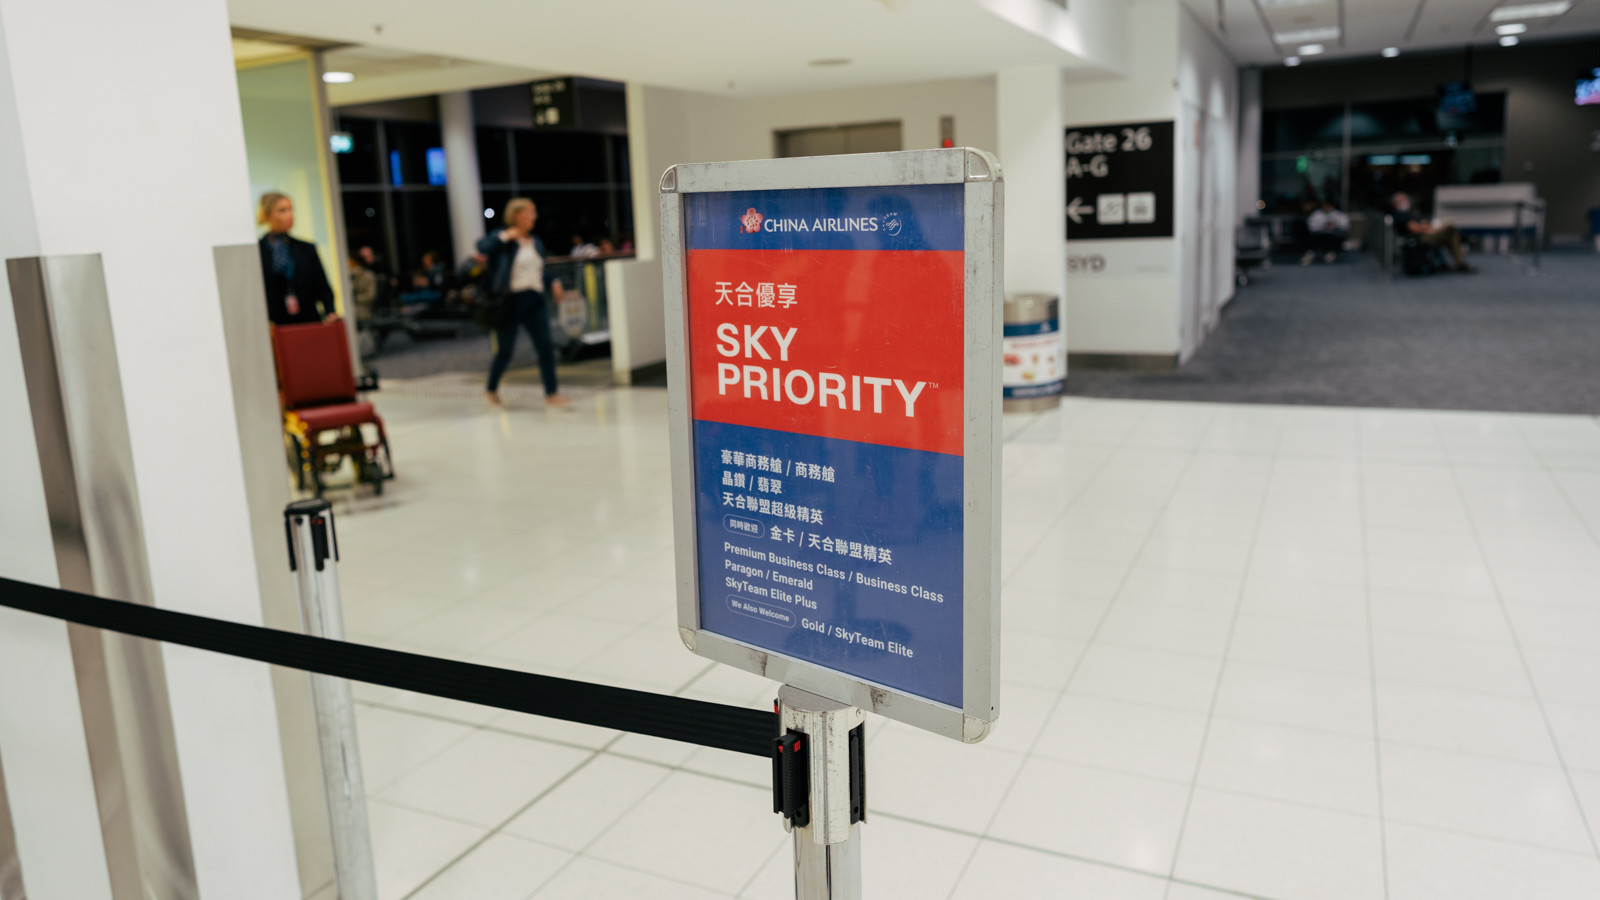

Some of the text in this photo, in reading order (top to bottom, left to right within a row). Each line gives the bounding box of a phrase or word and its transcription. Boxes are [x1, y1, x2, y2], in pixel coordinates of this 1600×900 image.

[1066, 127, 1152, 154] Gate 26
[1066, 155, 1109, 178] A-G
[764, 217, 877, 232] CHINA AIRLINES
[715, 281, 798, 308] 天合優享
[716, 322, 798, 362] SKY
[721, 449, 836, 483] 豪華商務艙 / 商務艙
[722, 471, 783, 495] 晶鑽 / 翡翠
[722, 492, 824, 525] 天合聯盟超級精英
[729, 519, 759, 534] 同時歡迎
[770, 525, 892, 565] 金卡 / 天合聯盟精英
[724, 542, 766, 561] Premium
[769, 552, 814, 572] Business
[816, 563, 845, 580] Class
[856, 573, 907, 595] Business
[910, 585, 944, 603] Class
[725, 560, 763, 578] Paragon
[772, 571, 813, 591] Emerald
[725, 577, 818, 610] SkyTeam Elite Plus
[731, 599, 790, 622] We Also Welcome
[801, 618, 825, 634] Gold
[835, 627, 885, 650] SkyTeam
[888, 642, 914, 658] Elite
